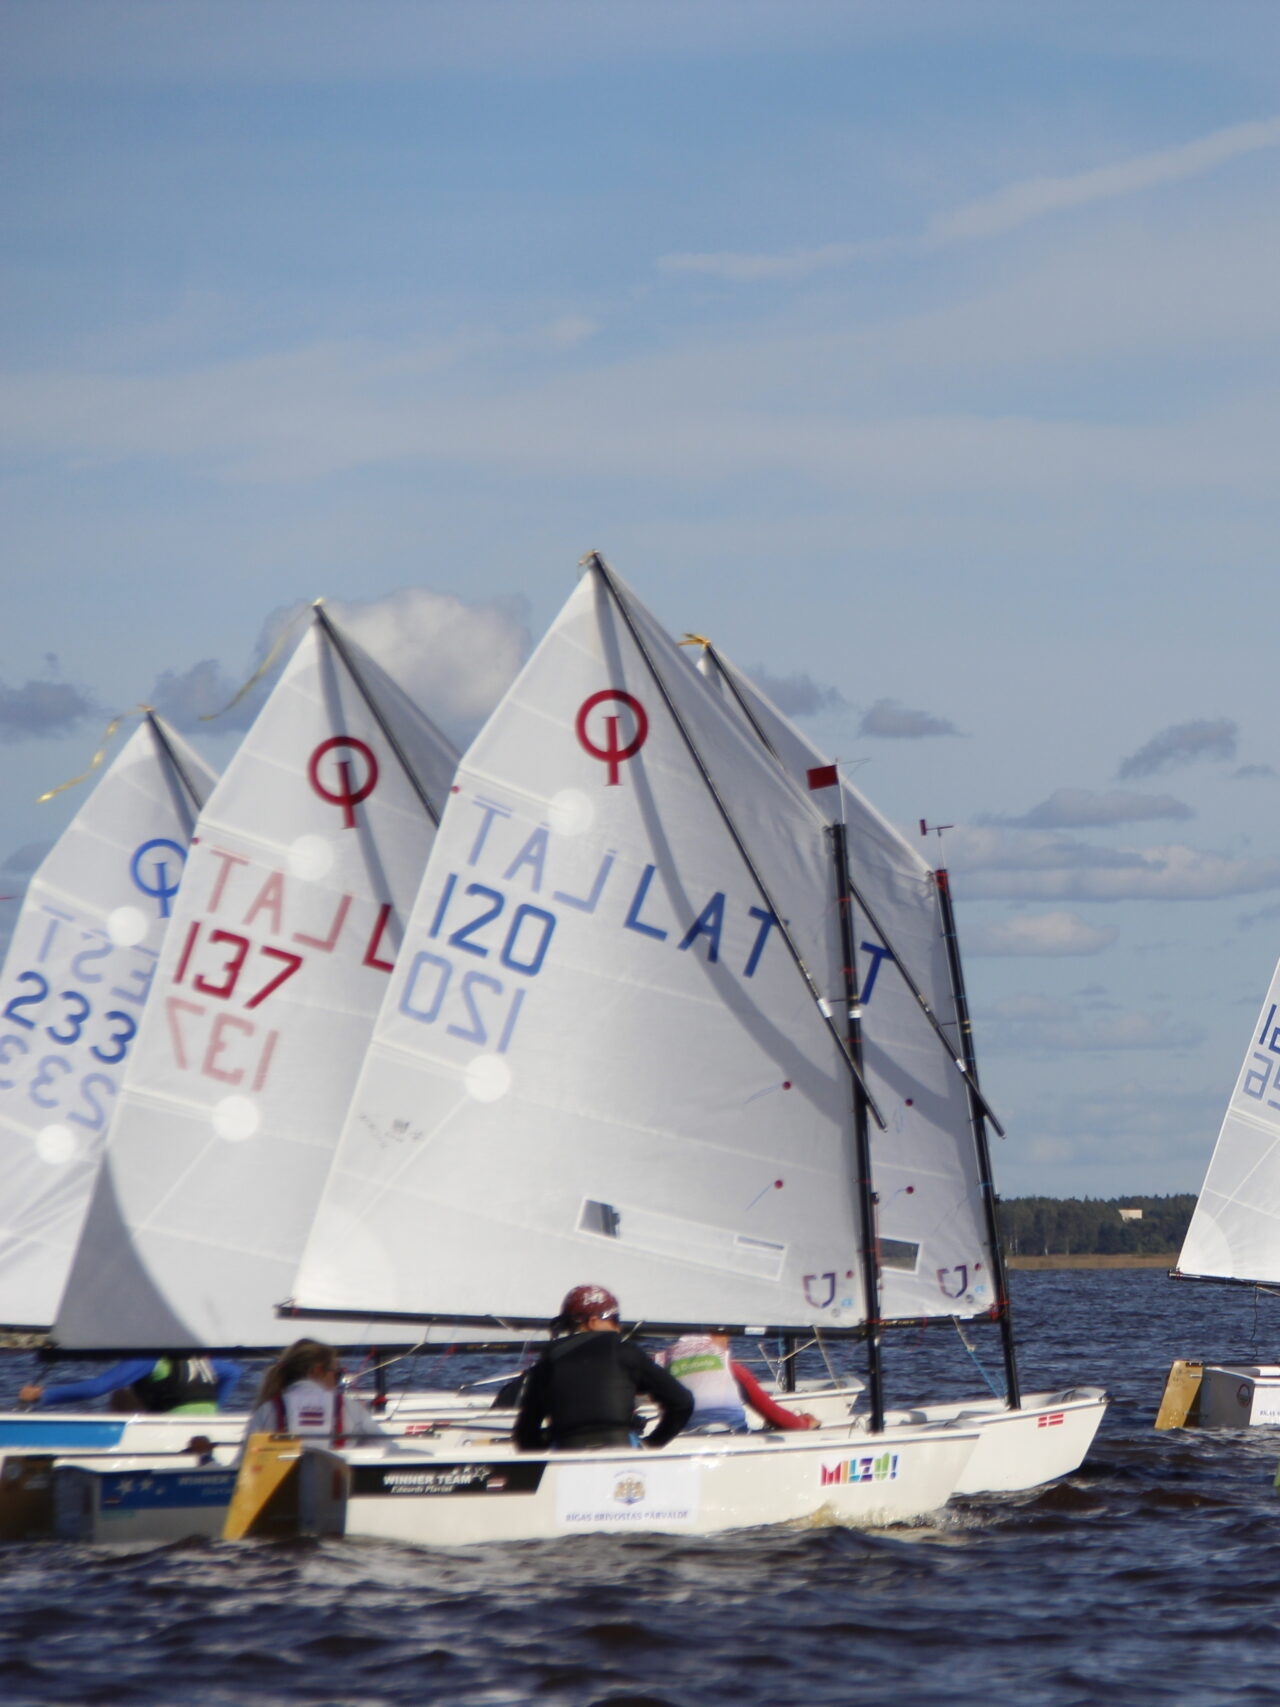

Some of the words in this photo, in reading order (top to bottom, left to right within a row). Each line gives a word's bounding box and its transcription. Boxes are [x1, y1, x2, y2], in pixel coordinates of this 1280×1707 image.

[173, 921, 302, 1009] 137
[429, 873, 557, 977] 120
[624, 864, 789, 978] LAT
[2, 970, 137, 1064] 233
[384, 1473, 433, 1485] WINNER
[437, 1473, 472, 1485] TEAM
